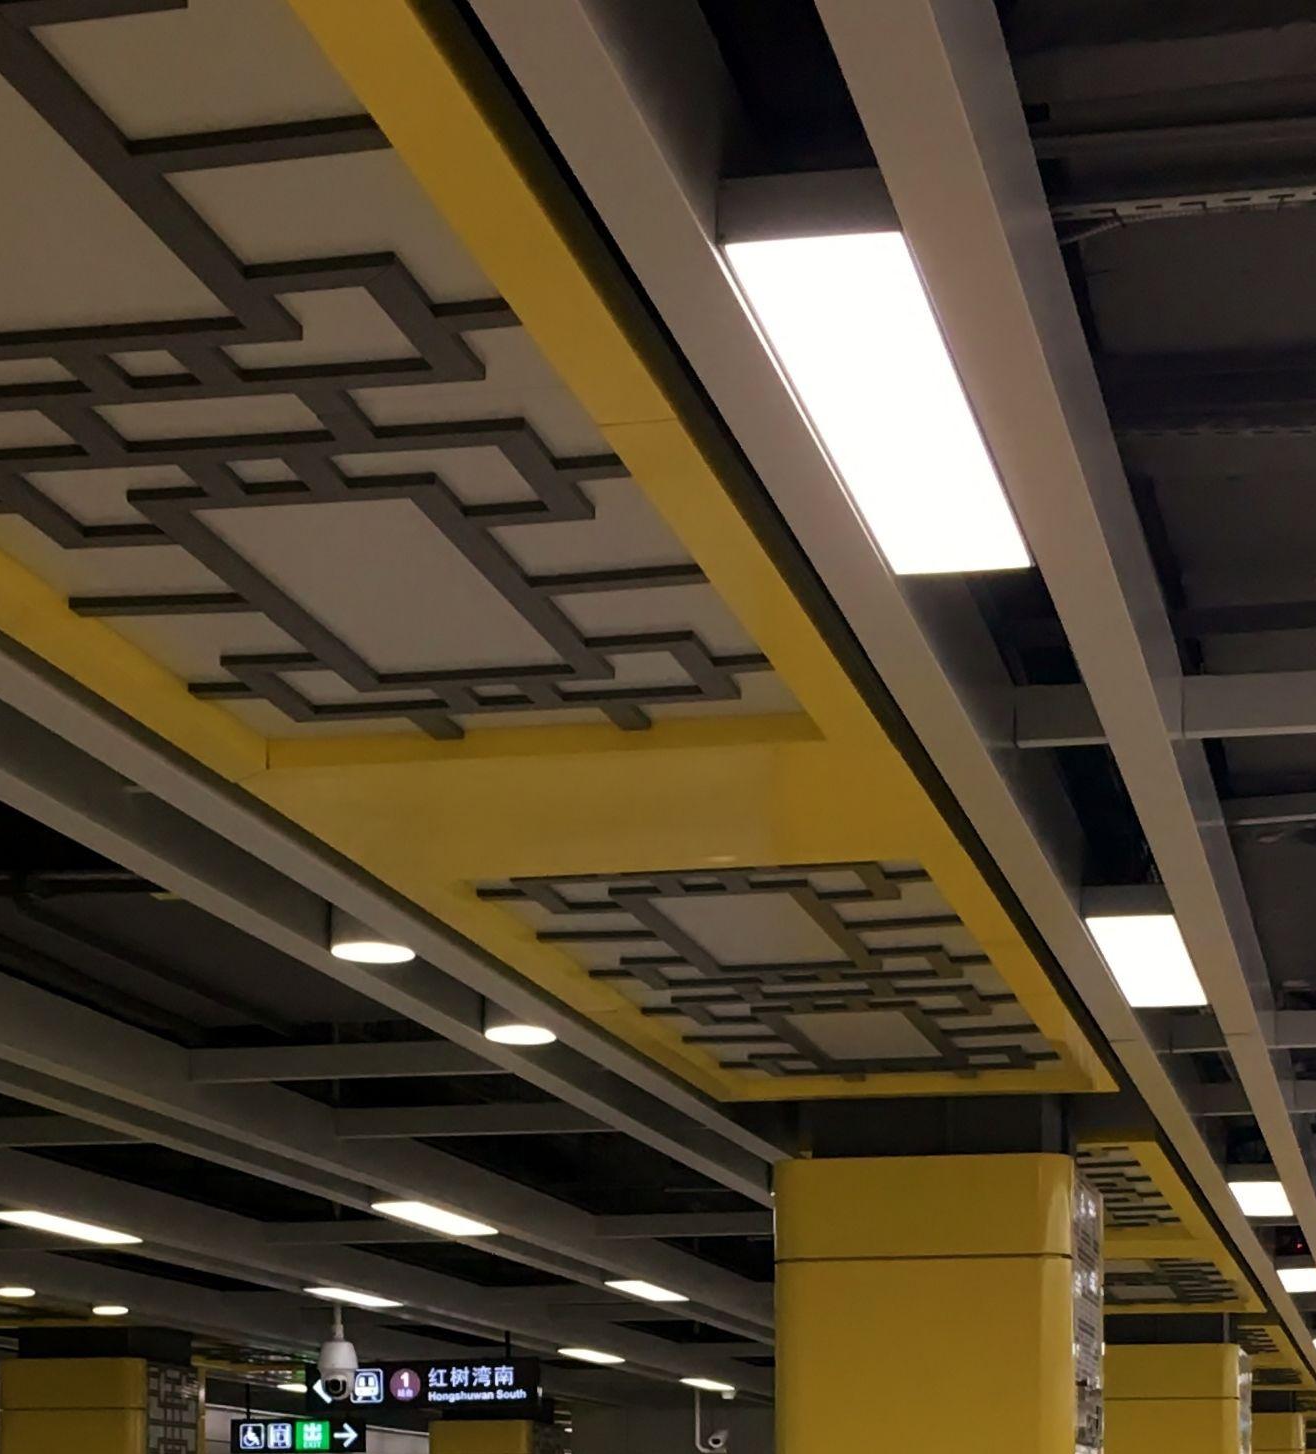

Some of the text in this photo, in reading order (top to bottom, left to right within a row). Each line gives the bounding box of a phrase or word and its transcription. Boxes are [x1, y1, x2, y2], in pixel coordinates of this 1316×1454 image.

[399, 1371, 411, 1388] 1
[427, 1365, 515, 1388] 红树湾南
[427, 1388, 527, 1403] Hongshuwan South
[302, 1441, 322, 1449] EXIT
